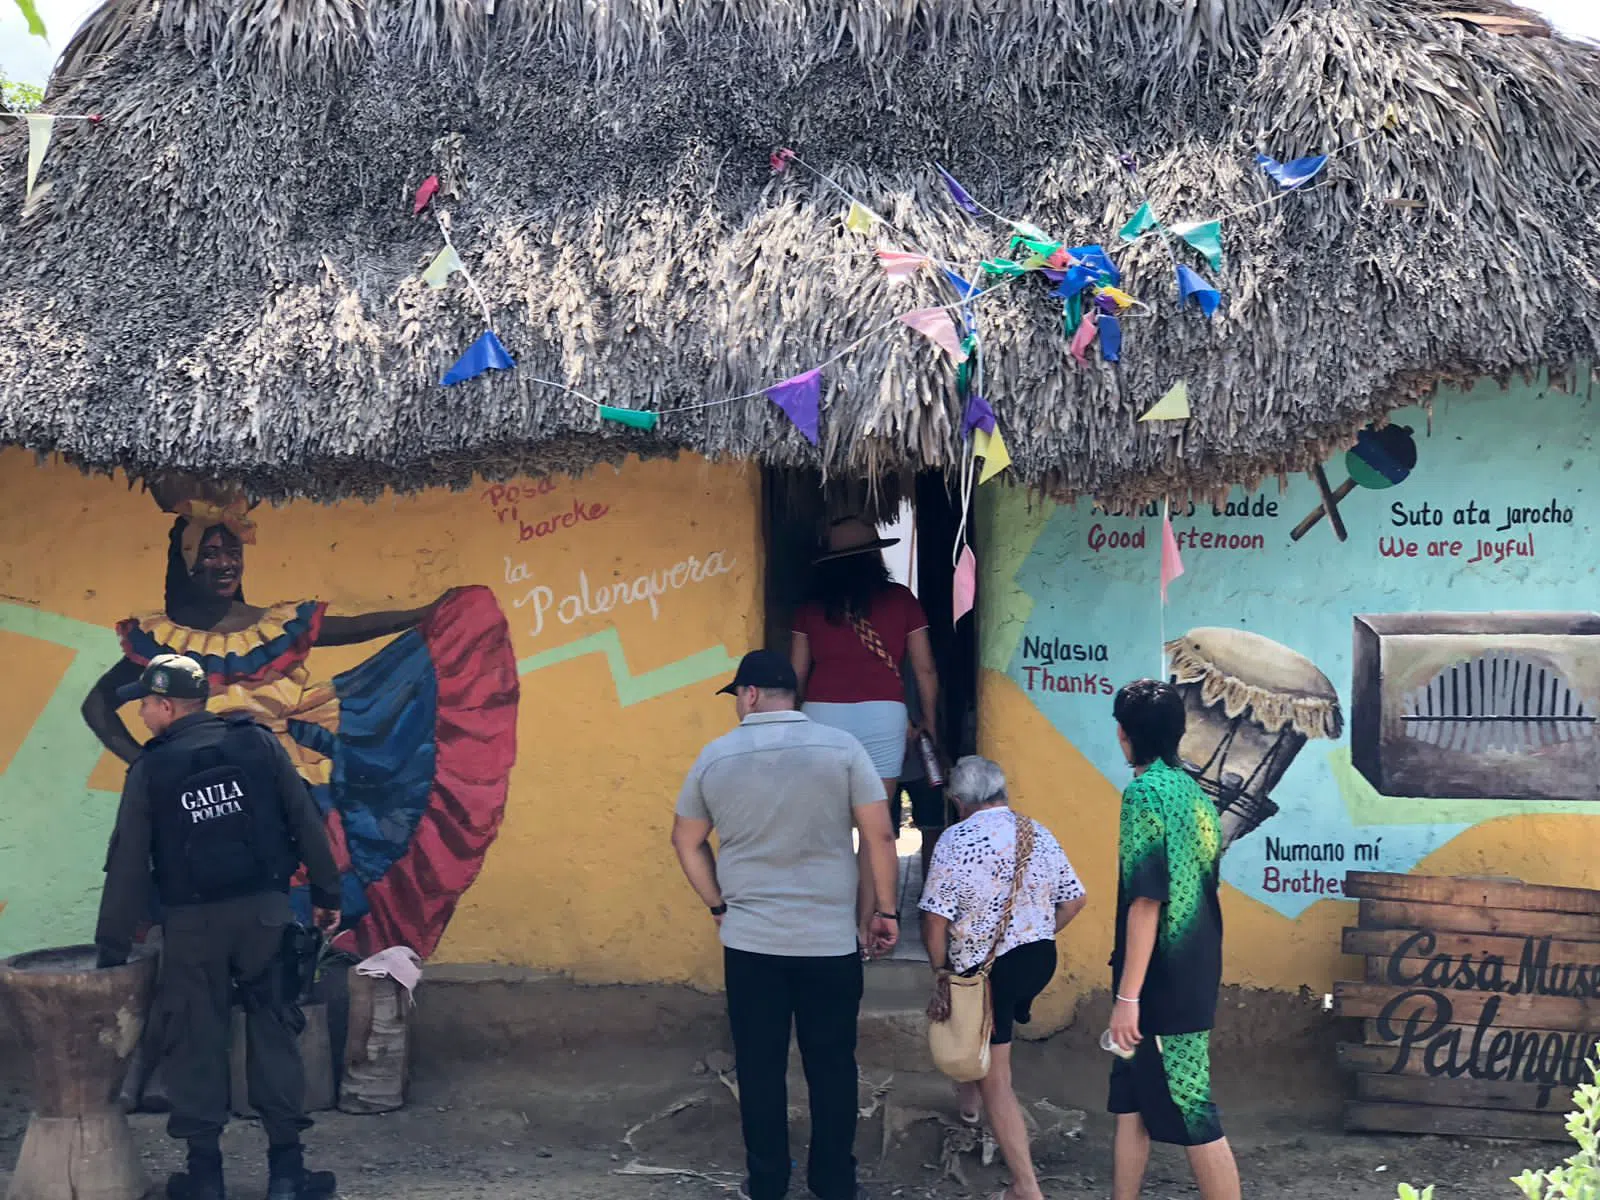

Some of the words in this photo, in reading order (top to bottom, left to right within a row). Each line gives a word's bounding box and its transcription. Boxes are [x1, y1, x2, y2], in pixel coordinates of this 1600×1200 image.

[518, 498, 609, 542] bareke
[1391, 501, 1443, 526] Suto
[1453, 500, 1490, 525] ata
[1088, 524, 1145, 552] Good
[1172, 526, 1265, 551] ftenoon
[1378, 536, 1418, 558] We
[1427, 539, 1463, 557] are
[1467, 532, 1534, 564] joyful
[504, 555, 534, 584] la
[513, 550, 737, 637] Palenquera
[1022, 666, 1114, 695] Thanks
[181, 780, 244, 810] GAULA
[191, 800, 243, 824] POLICIA
[1265, 836, 1345, 862] Numano
[1387, 928, 1510, 993] Casa
